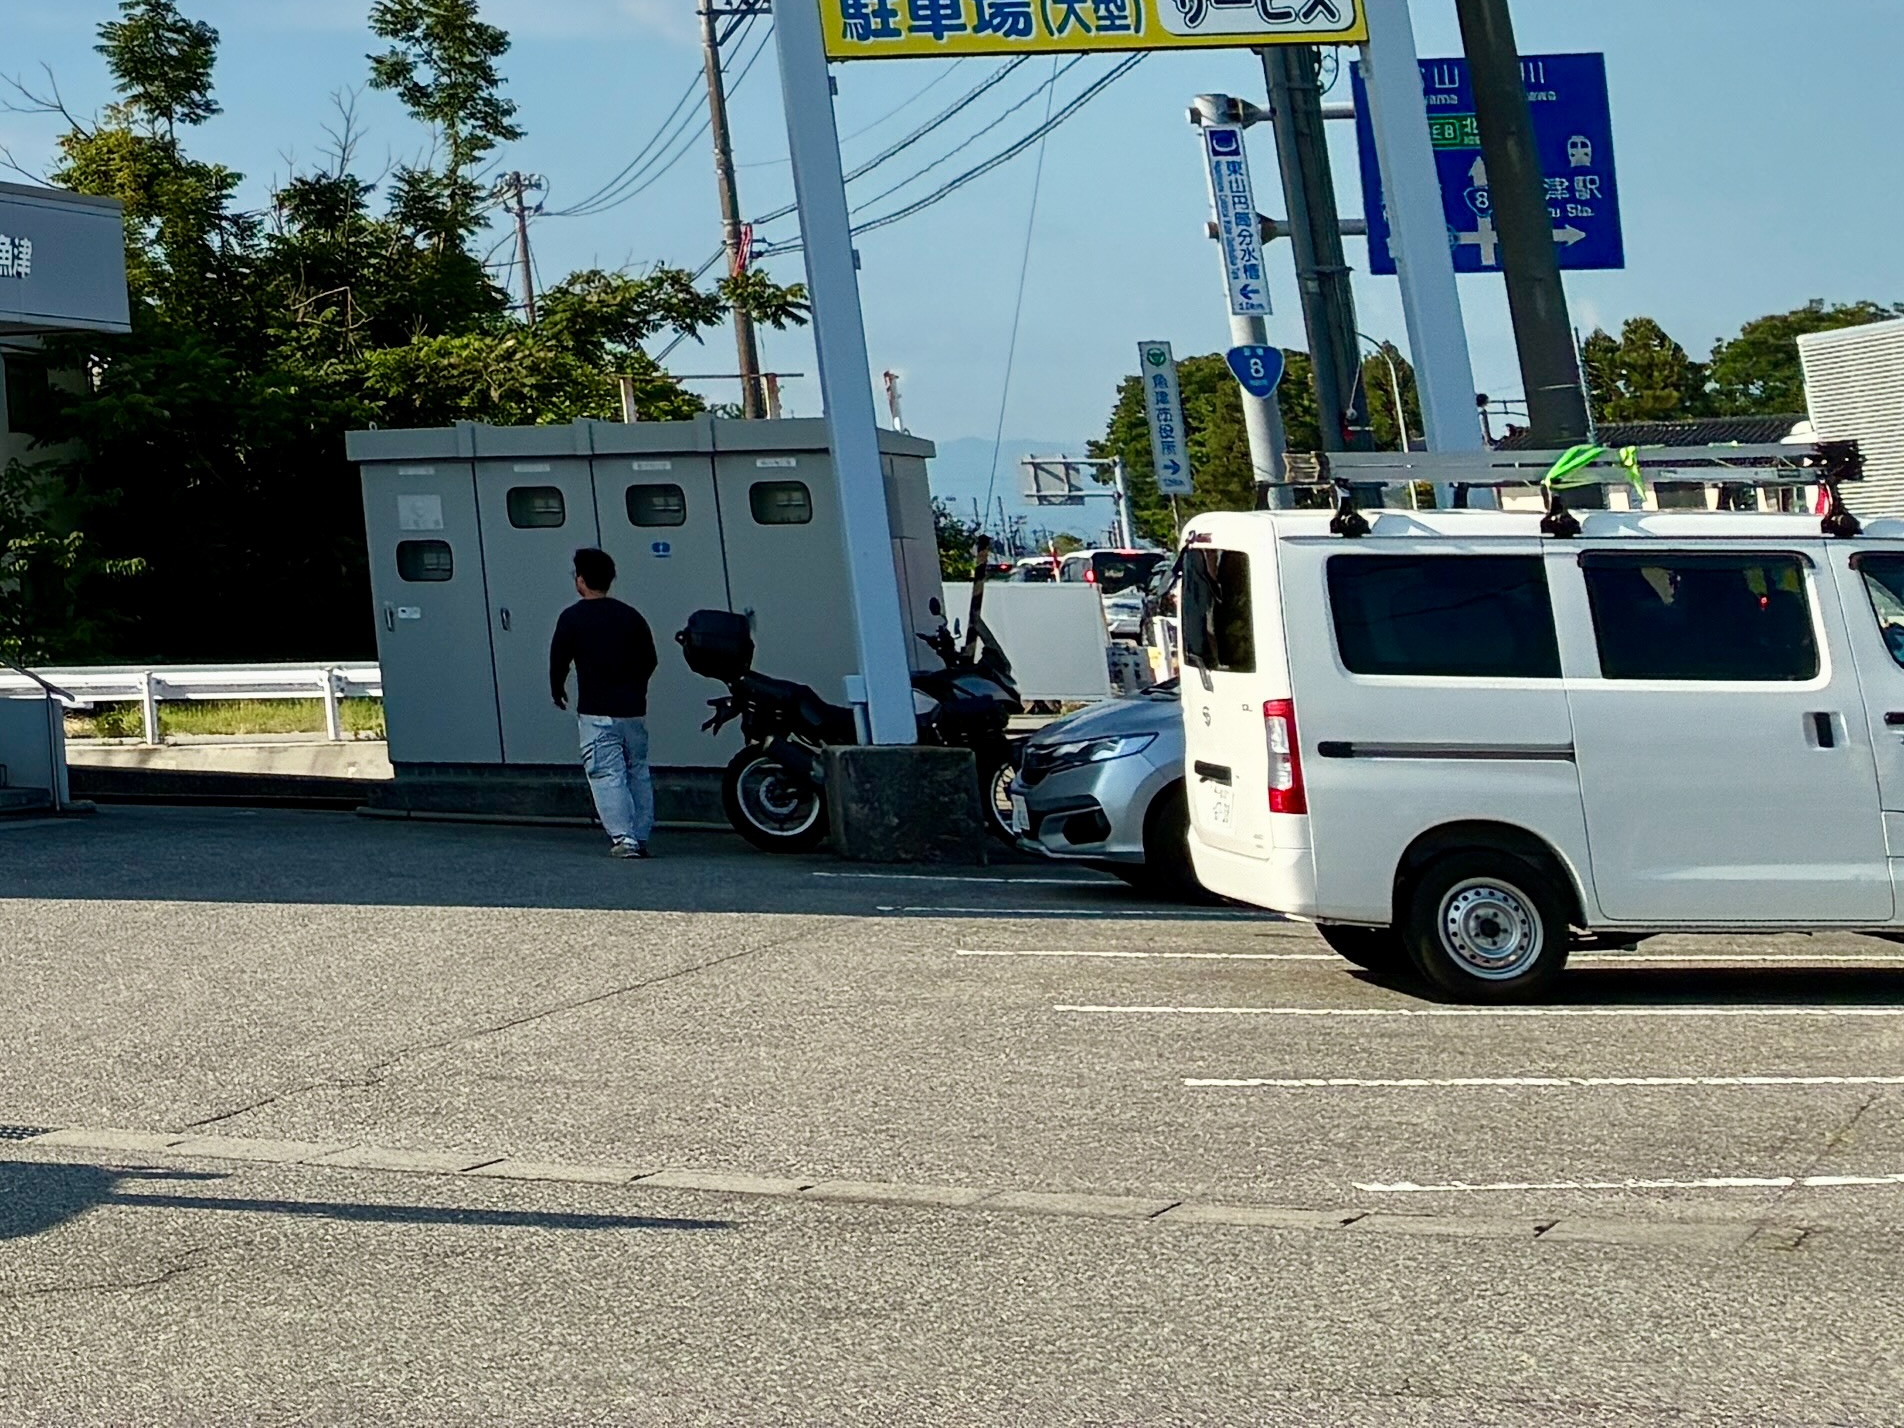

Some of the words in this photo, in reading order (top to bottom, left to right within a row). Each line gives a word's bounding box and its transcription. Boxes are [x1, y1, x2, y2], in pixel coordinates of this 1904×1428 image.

[1544, 175, 1602, 200] 津駅
[1475, 191, 1489, 208] 8
[1250, 358, 1264, 377] 8
